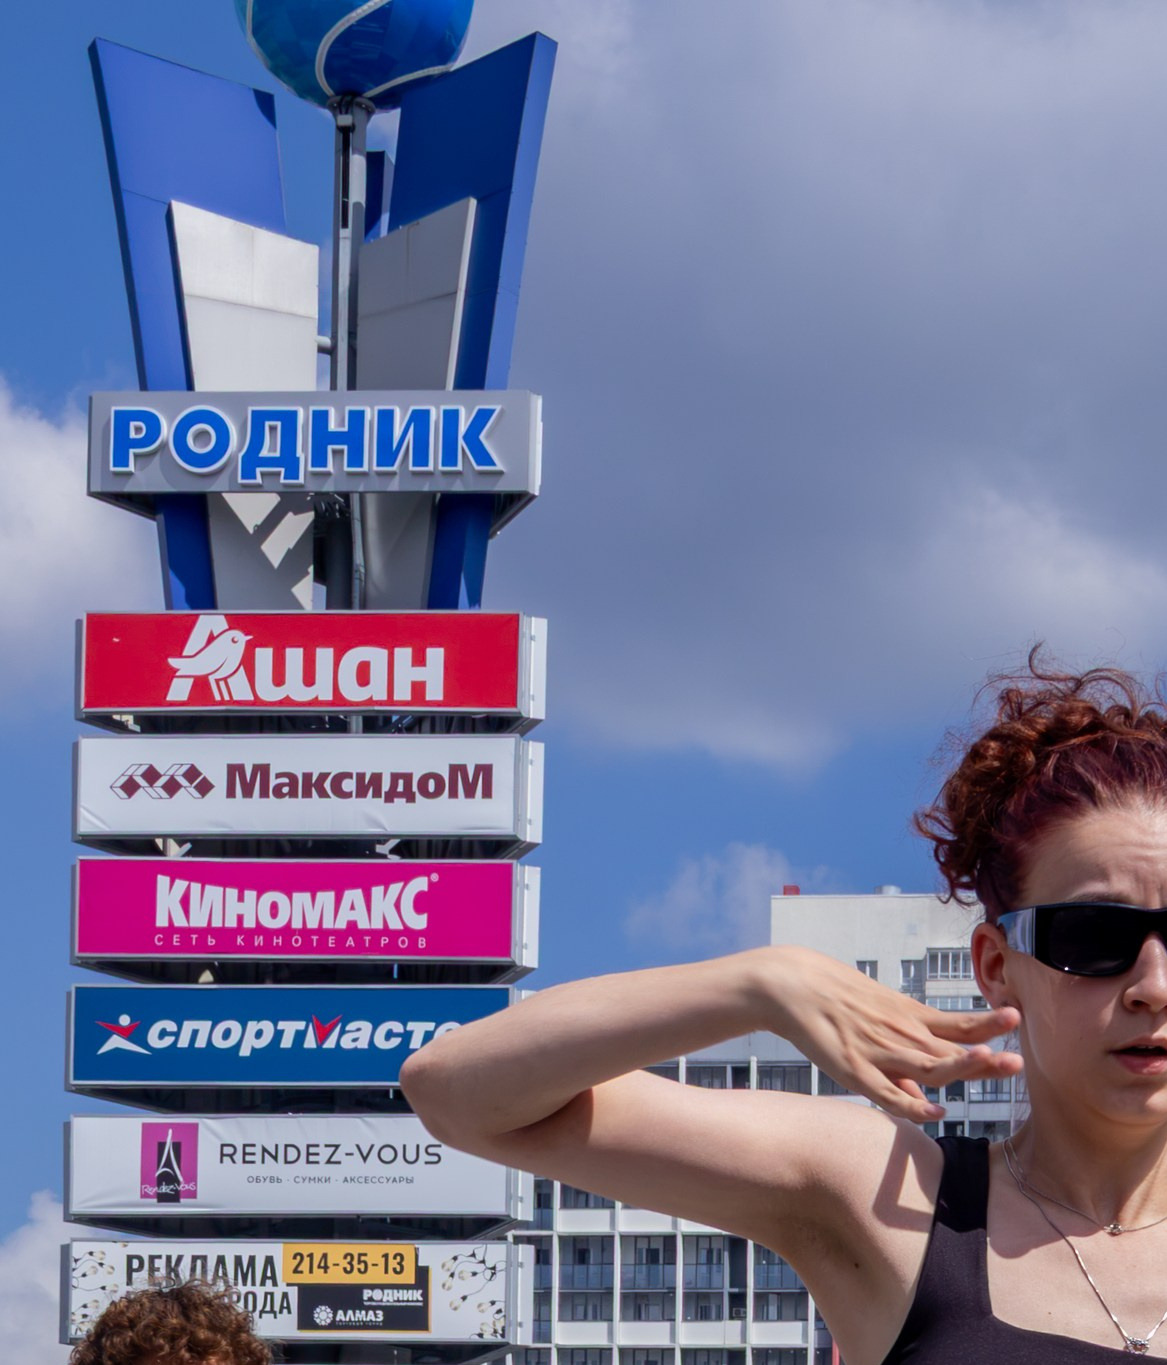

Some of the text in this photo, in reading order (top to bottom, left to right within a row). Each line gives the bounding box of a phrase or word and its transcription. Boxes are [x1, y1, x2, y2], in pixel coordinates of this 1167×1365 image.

[109, 404, 506, 485] РОДНИК
[165, 614, 445, 702] Ашан
[225, 763, 493, 804] МаксидоМ
[155, 873, 428, 930] КИНОМАКС
[154, 933, 428, 950] СЕТЬ КИНОТЕАТРОВ
[218, 1142, 443, 1166] RENDEZ-VOUS
[246, 1174, 415, 1184] ОБУВЬ СУМКИ АКСЕССУАРЫ
[125, 1254, 279, 1288] РЕКЛАМА
[291, 1252, 406, 1276] 214-35-13
[362, 1288, 424, 1303] РОДНИК
[335, 1309, 384, 1322] АЛМАЗ
